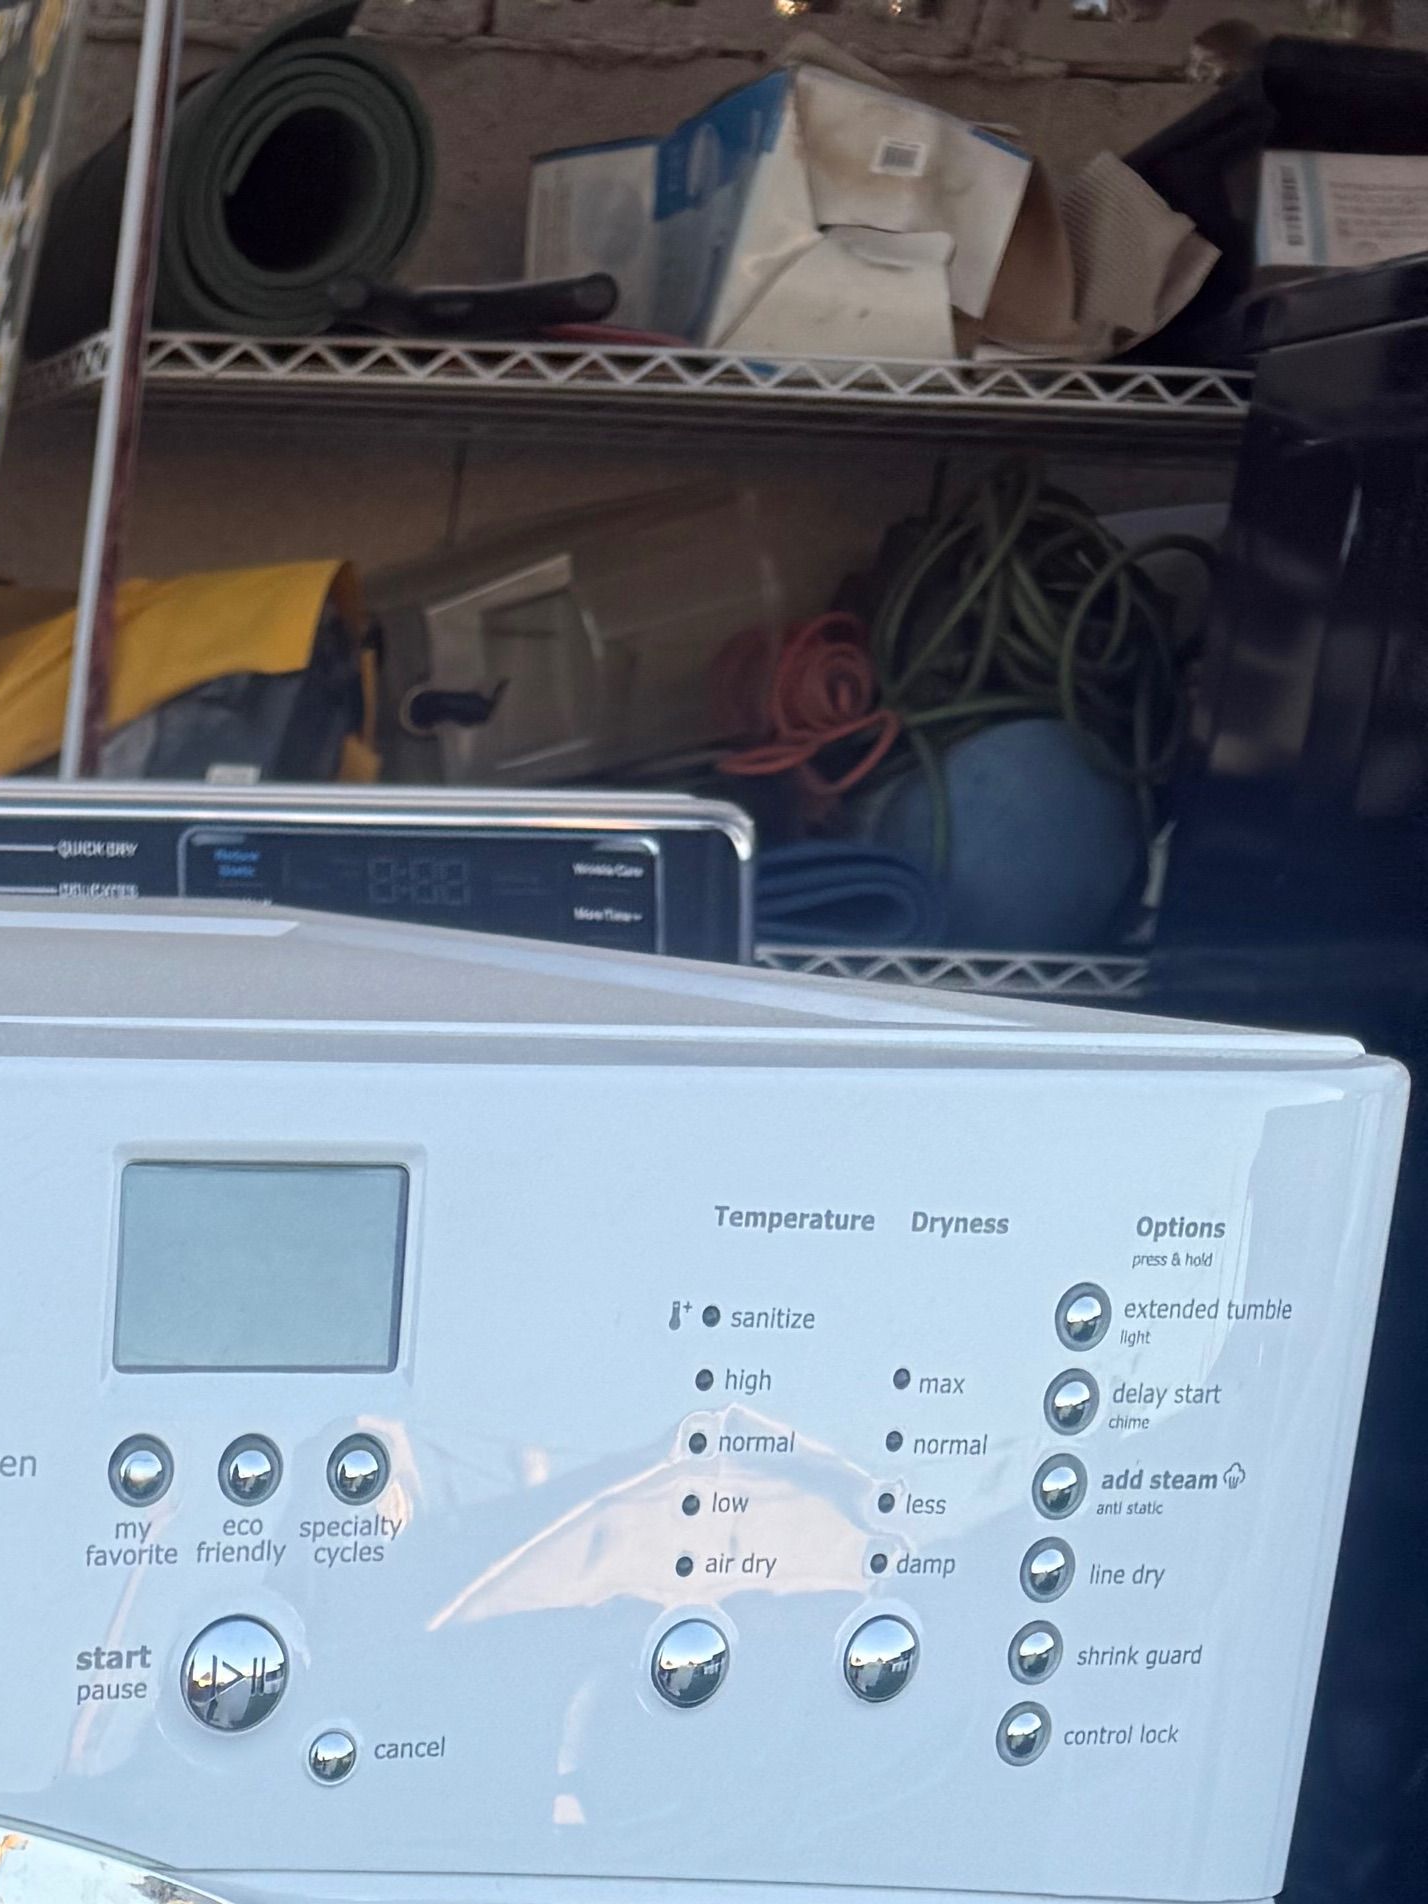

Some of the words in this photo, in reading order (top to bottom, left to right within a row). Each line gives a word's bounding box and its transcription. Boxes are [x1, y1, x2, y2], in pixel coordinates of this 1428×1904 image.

[714, 1206, 875, 1233] Temperature
[911, 1211, 1009, 1238] Dryness
[1136, 1216, 1225, 1242] Options
[1132, 1254, 1166, 1269] press
[1185, 1252, 1212, 1267] hold
[731, 1306, 815, 1329] sanitize
[1124, 1299, 1219, 1321] extended
[1227, 1299, 1292, 1320] tumble
[1120, 1328, 1151, 1347] light
[725, 1368, 772, 1392] high
[919, 1374, 964, 1394] max
[1112, 1383, 1167, 1408] delay
[1174, 1383, 1221, 1404] start
[1108, 1414, 1149, 1429] chime
[718, 1431, 794, 1453] normal
[913, 1434, 987, 1456] normal
[1101, 1467, 1142, 1490] add
[1149, 1470, 1217, 1490] steam
[711, 1491, 748, 1514] low
[906, 1493, 946, 1514] less
[1096, 1500, 1122, 1514] anti
[1126, 1500, 1162, 1516] static
[115, 1519, 151, 1541] my
[222, 1518, 263, 1536] eco
[299, 1515, 402, 1540] specialty
[86, 1544, 178, 1567] favorite
[196, 1542, 285, 1566] friendly
[314, 1542, 384, 1566] cycles
[705, 1553, 735, 1573] air
[742, 1553, 776, 1578] dry
[896, 1553, 955, 1578] damp
[1089, 1564, 1129, 1584] line
[1132, 1564, 1165, 1589] dry
[76, 1645, 151, 1670] start
[1077, 1645, 1139, 1666] shrink
[1145, 1645, 1202, 1670] guard
[76, 1680, 147, 1703] pause
[1063, 1725, 1132, 1745] control
[1140, 1724, 1178, 1744] lock
[374, 1737, 445, 1760] cancel
